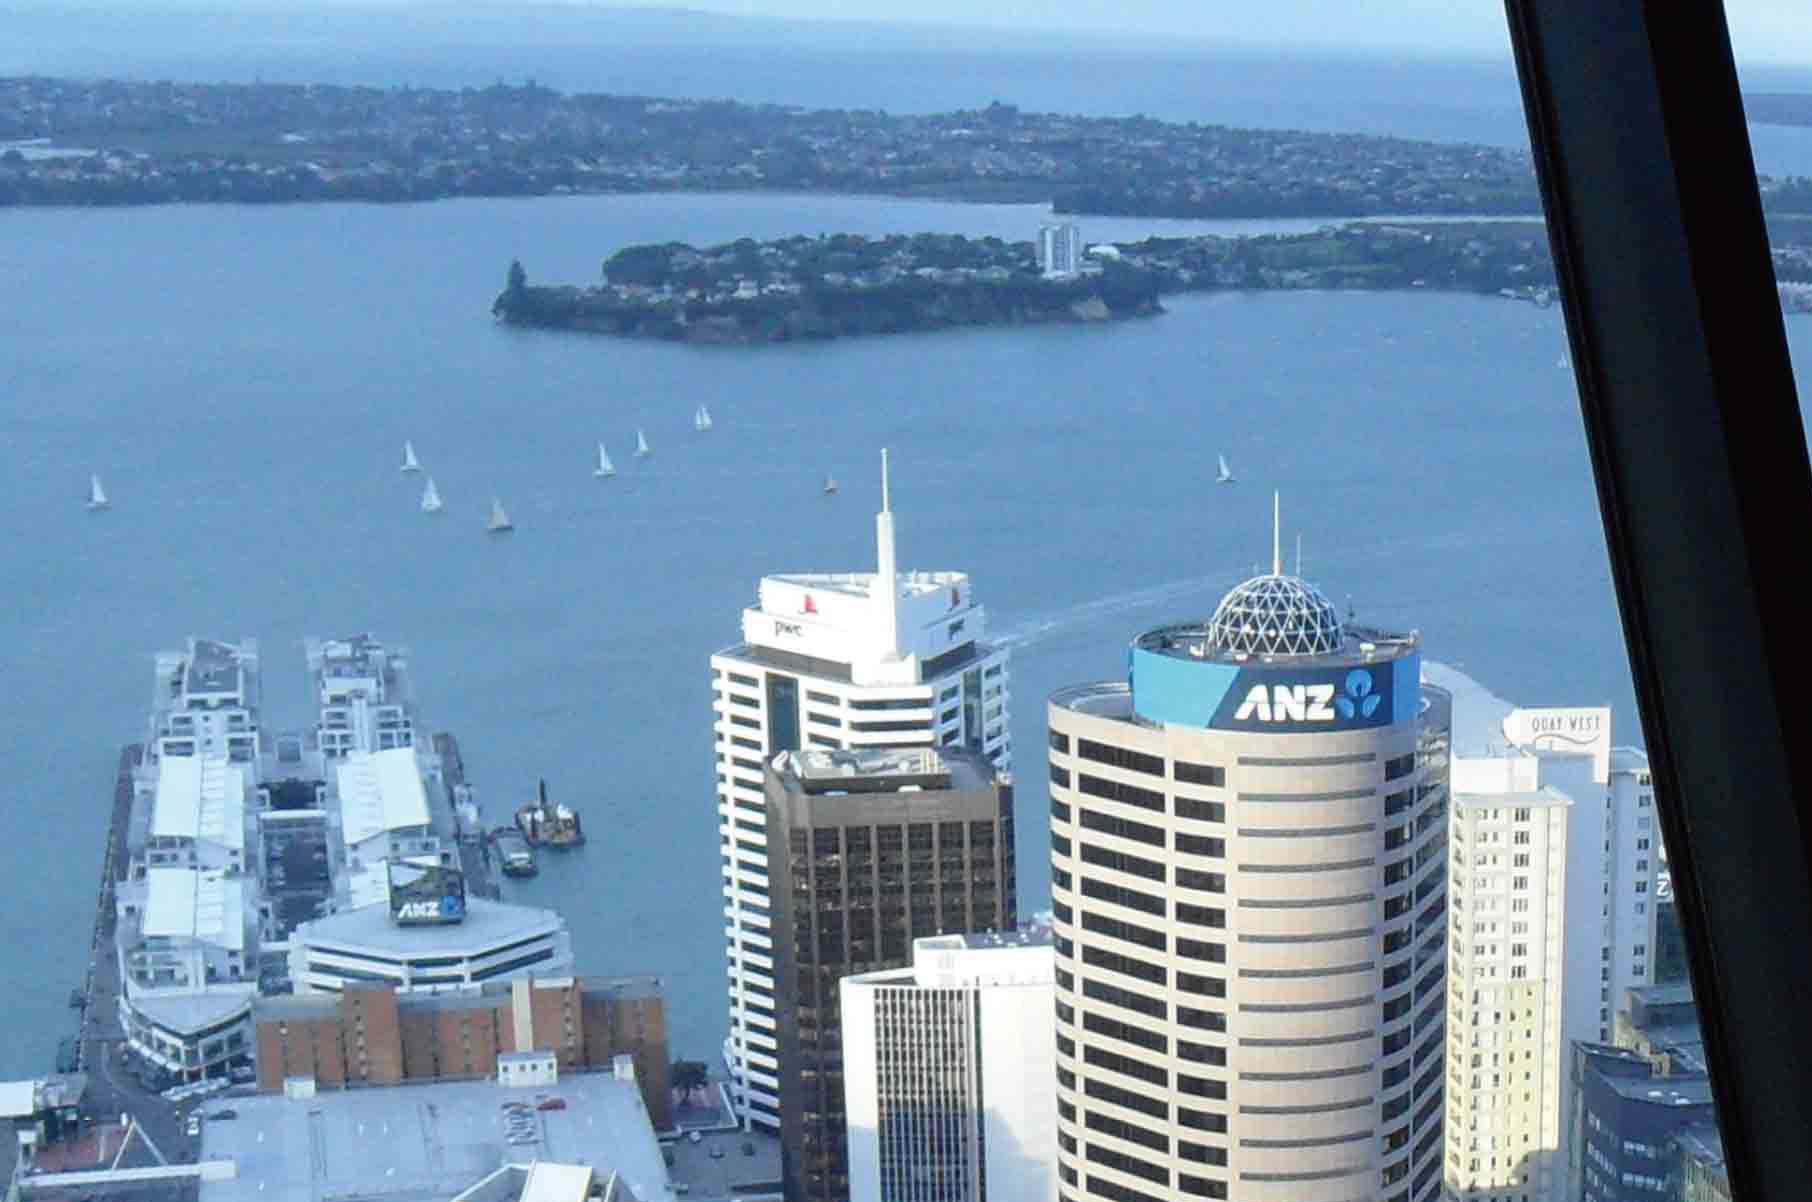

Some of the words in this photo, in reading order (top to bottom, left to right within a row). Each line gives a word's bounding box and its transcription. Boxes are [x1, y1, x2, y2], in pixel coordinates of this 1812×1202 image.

[1234, 684, 1335, 721] ANZ
[1531, 717, 1562, 733] QUAY
[1567, 715, 1601, 731] WEST
[398, 902, 440, 919] ANZ
